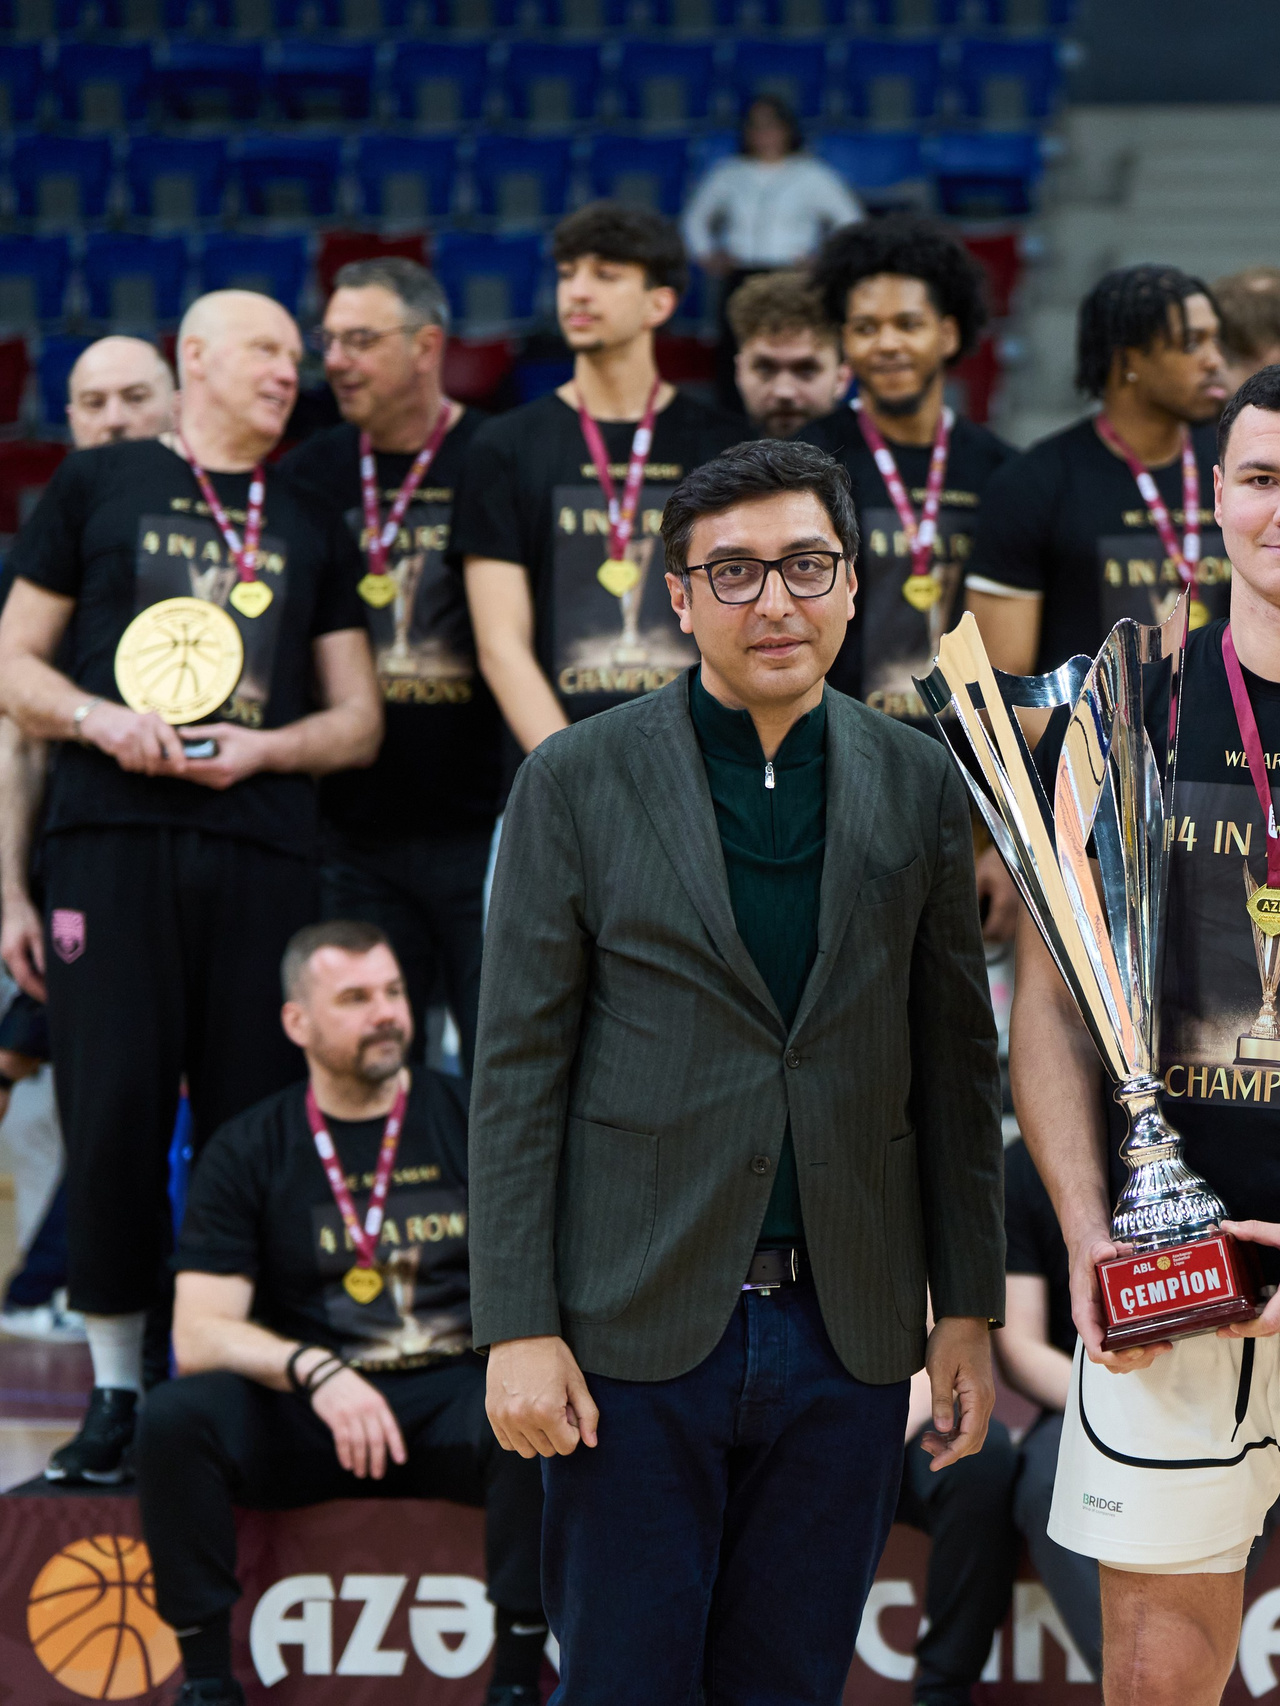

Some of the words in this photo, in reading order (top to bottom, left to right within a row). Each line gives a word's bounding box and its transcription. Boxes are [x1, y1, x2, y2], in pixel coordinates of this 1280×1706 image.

[1225, 750, 1250, 768] WE
[1177, 815, 1198, 852] 4
[1213, 820, 1253, 856] IN
[1133, 1262, 1156, 1275] ABL
[1120, 1267, 1221, 1314] ÇEMPİON
[1083, 1493, 1123, 1513] BRIDGE
